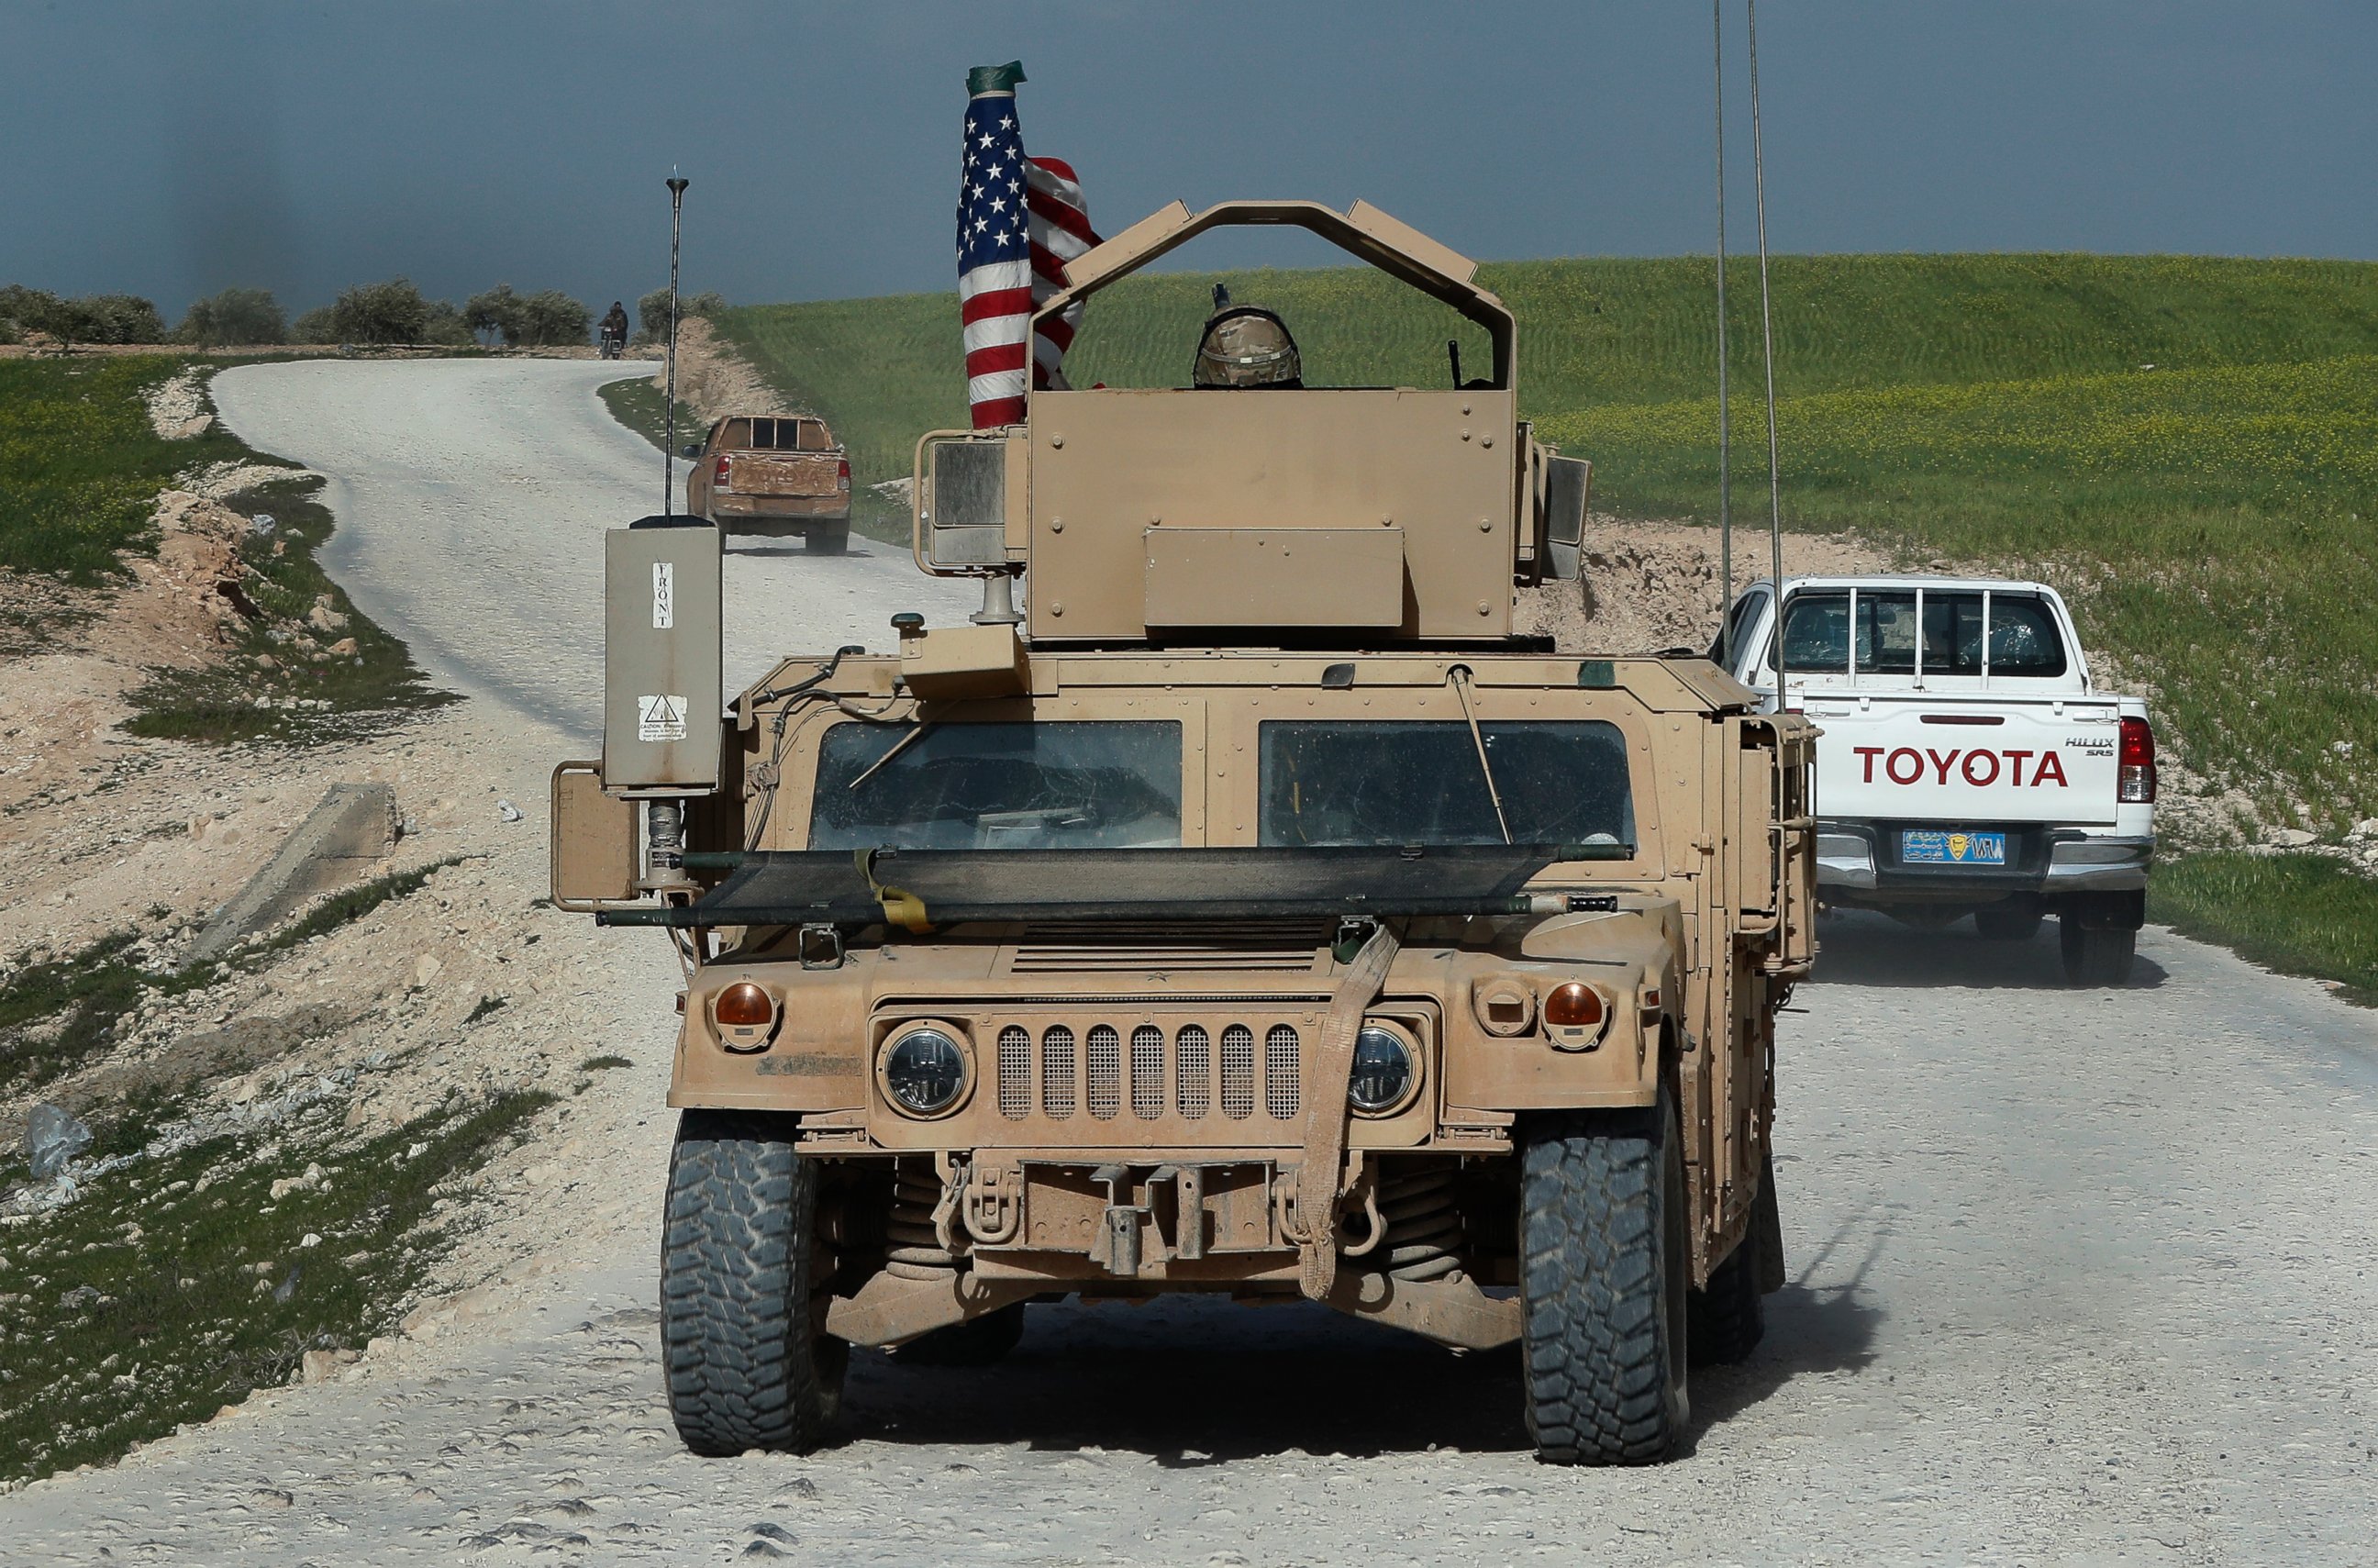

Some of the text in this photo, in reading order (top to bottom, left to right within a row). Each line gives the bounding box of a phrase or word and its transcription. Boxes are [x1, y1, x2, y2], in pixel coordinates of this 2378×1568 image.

[658, 563, 668, 626] FRONT
[2065, 738, 2114, 748] HILUX
[1853, 747, 2068, 787] TOYOTA
